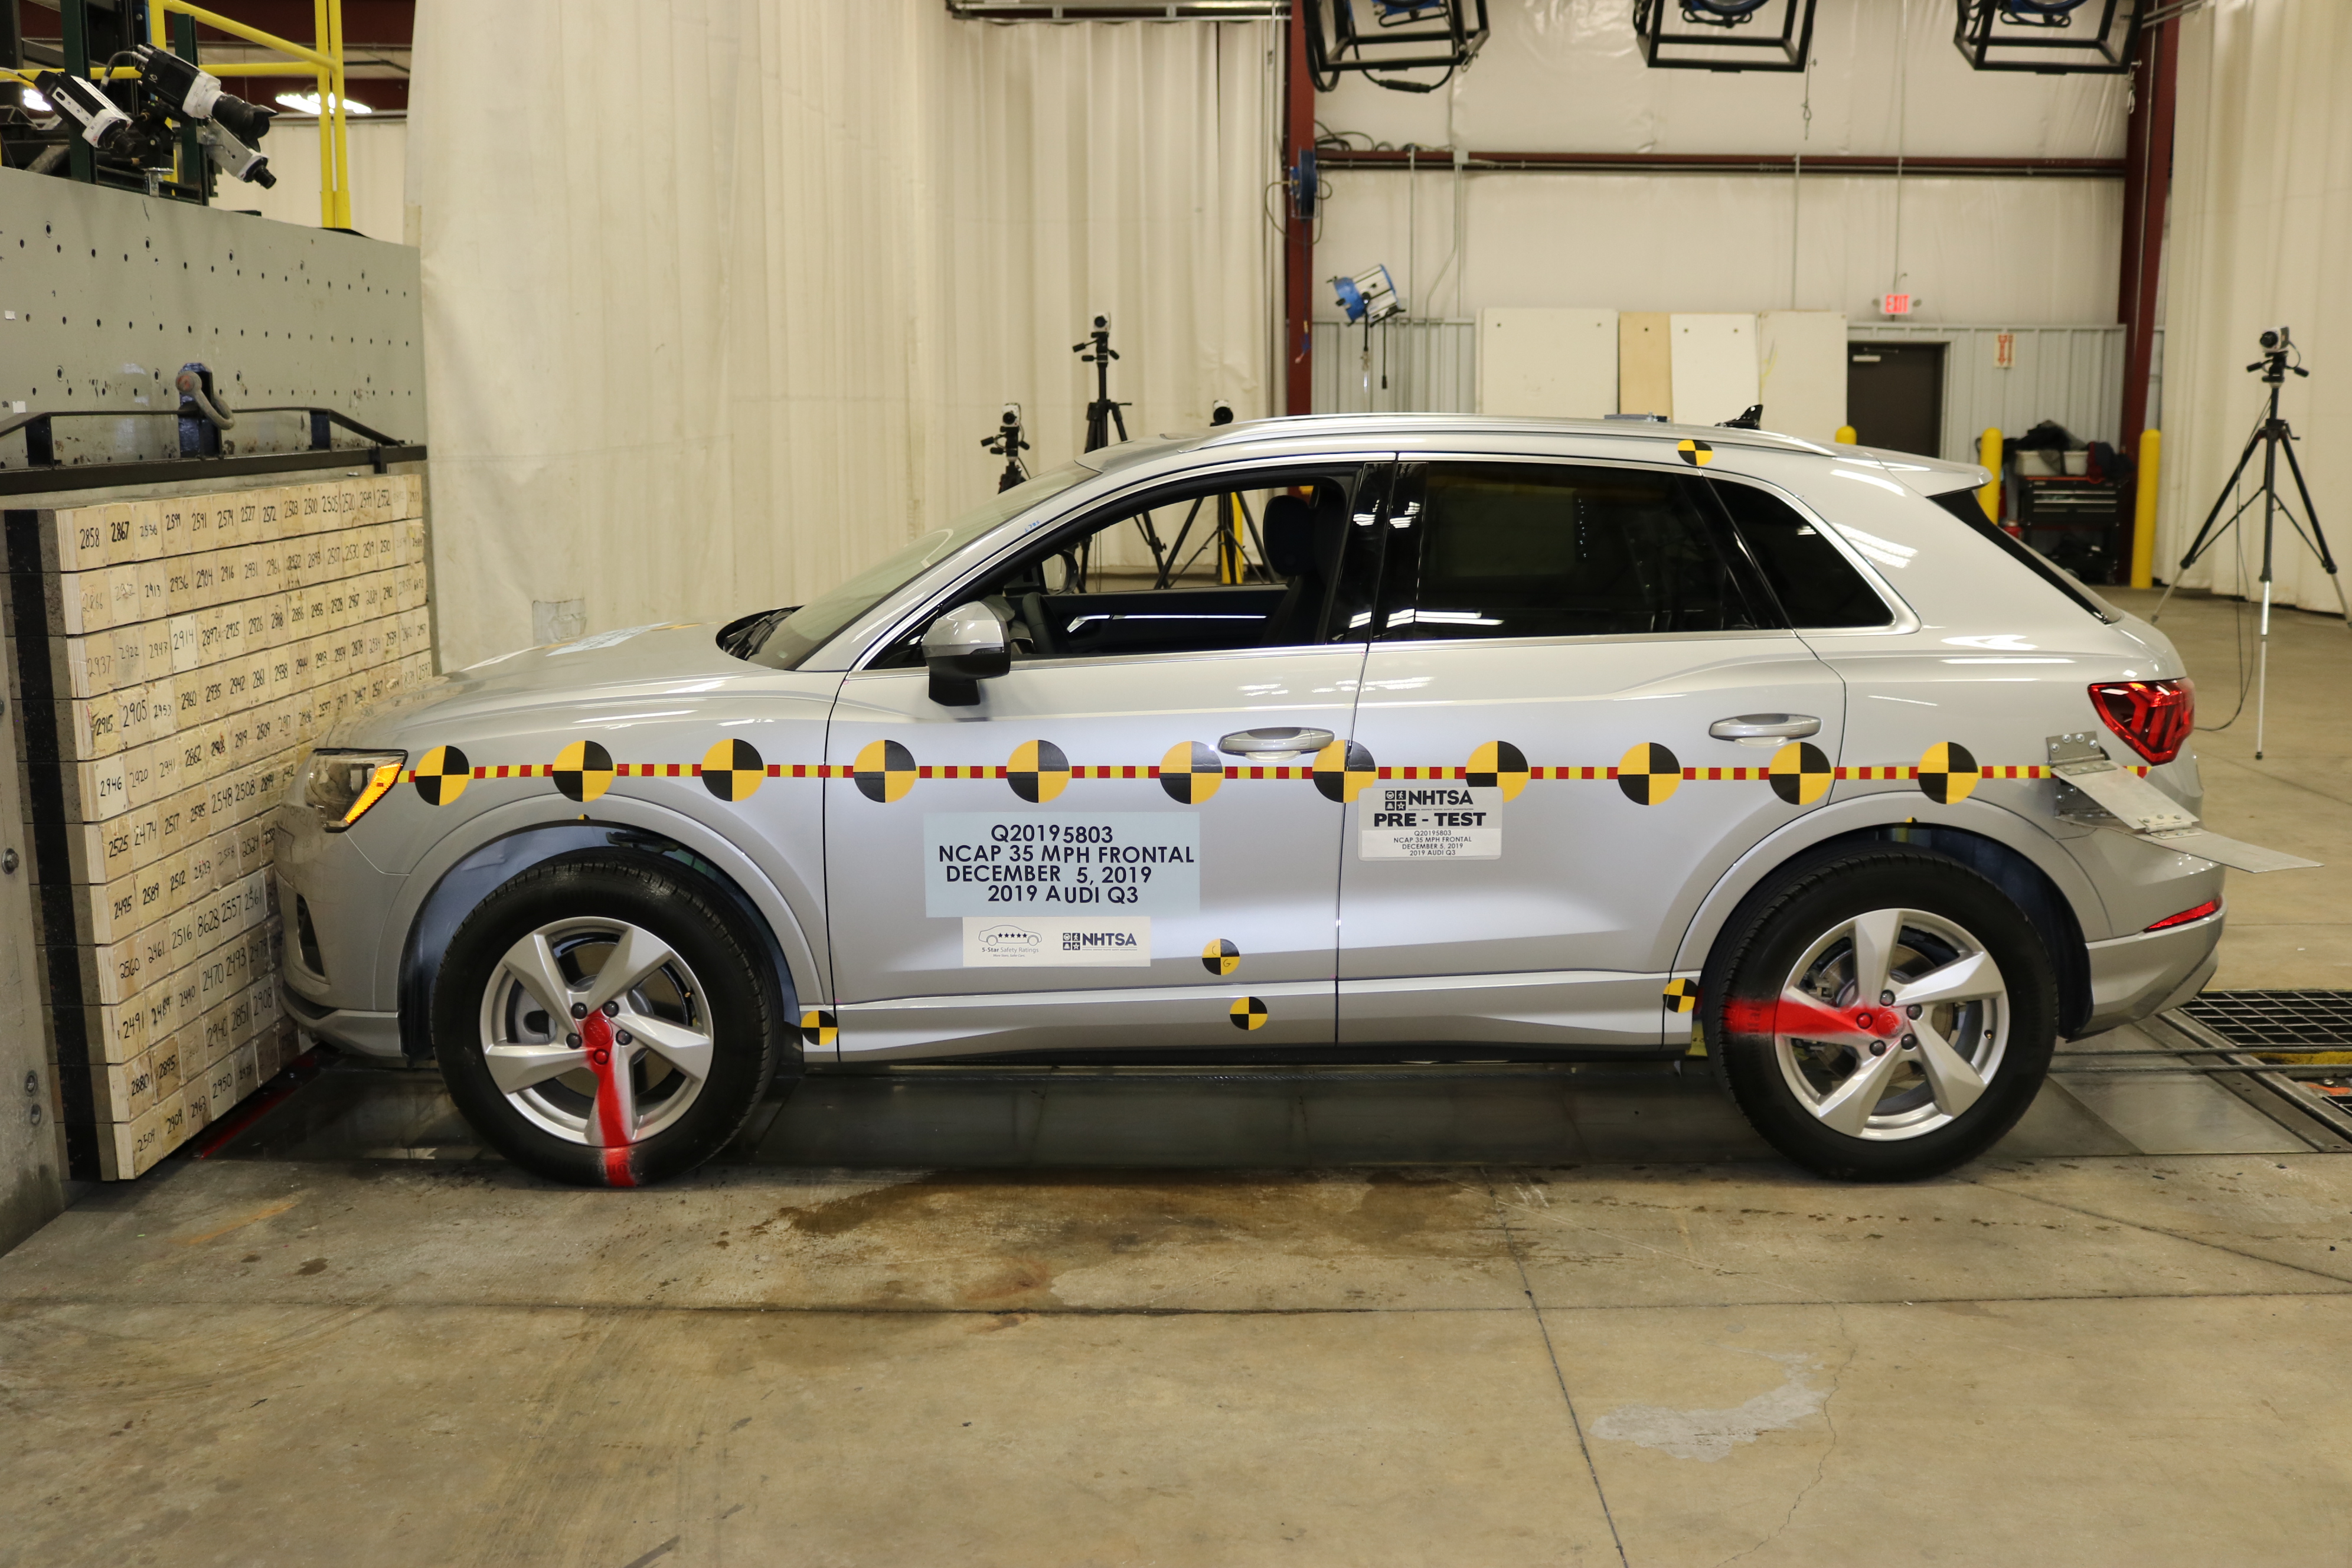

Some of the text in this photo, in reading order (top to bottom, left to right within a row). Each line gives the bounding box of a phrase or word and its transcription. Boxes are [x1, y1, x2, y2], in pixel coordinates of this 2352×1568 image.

[1885, 294, 1910, 313] EXIT
[241, 506, 256, 522] 2527
[263, 506, 277, 522] 2572
[285, 501, 299, 518] 2503
[304, 498, 318, 515] 2500
[322, 496, 338, 512] 2505
[192, 512, 207, 531] 2591
[217, 509, 234, 529] 2574
[80, 527, 100, 550] 2858
[111, 521, 130, 543] 2867
[140, 524, 158, 537] 2536
[197, 568, 213, 589] 2904
[221, 566, 234, 582] 2916
[245, 562, 257, 579] 2931
[145, 582, 161, 597] 2913
[171, 575, 188, 592] 2936
[83, 593, 103, 613] 2866
[226, 622, 239, 639] 2925
[249, 615, 263, 635] 2926
[174, 629, 194, 650] 2914
[119, 645, 139, 659] 2922
[149, 642, 167, 658] 2947
[88, 656, 110, 677] 2937
[275, 663, 288, 682] 2938
[206, 683, 221, 703] 2935
[230, 676, 245, 694] 2942
[181, 691, 197, 710] 2960
[123, 700, 147, 727] 2905
[154, 704, 172, 720] 2953
[96, 714, 113, 736] 2915
[185, 745, 202, 767] 2862
[130, 769, 148, 788] 2920
[159, 759, 175, 778] 2941
[100, 776, 122, 796] 2946
[235, 779, 256, 801] 2508
[211, 787, 233, 814] 2548
[1409, 790, 1474, 805] NHTSA
[165, 813, 179, 835] 2517
[1374, 813, 1417, 827] PRE
[1434, 812, 1487, 827] TEST
[991, 825, 1113, 844] Q20195803
[109, 835, 128, 858] 2525
[939, 845, 1194, 863] NCAP 35 MPH FRONTAL
[171, 870, 185, 892] 2512
[947, 865, 1152, 886] DECEMBER 5, 2019
[143, 883, 159, 906] 2589
[244, 887, 262, 910] 2561
[988, 885, 1138, 904] 2019 AUDI Q3
[114, 895, 132, 920] 2495
[221, 895, 241, 922] 2557
[198, 909, 220, 937] 8628
[172, 925, 192, 949] 2516
[1082, 933, 1137, 946] NHTSA
[148, 940, 164, 963] 2461
[226, 947, 246, 976] 2493
[119, 958, 140, 978] 2560
[202, 963, 224, 992] 2470
[179, 985, 195, 1007] 2490
[254, 987, 272, 1016] 2908
[151, 996, 171, 1025] 2489
[231, 1002, 249, 1031] 2851
[123, 1011, 144, 1038] 2491
[158, 1054, 175, 1080] 2895
[213, 1073, 233, 1099] 2950
[191, 1096, 206, 1118] 2963
[166, 1109, 183, 1135] 2909
[138, 1127, 156, 1152] 2504
